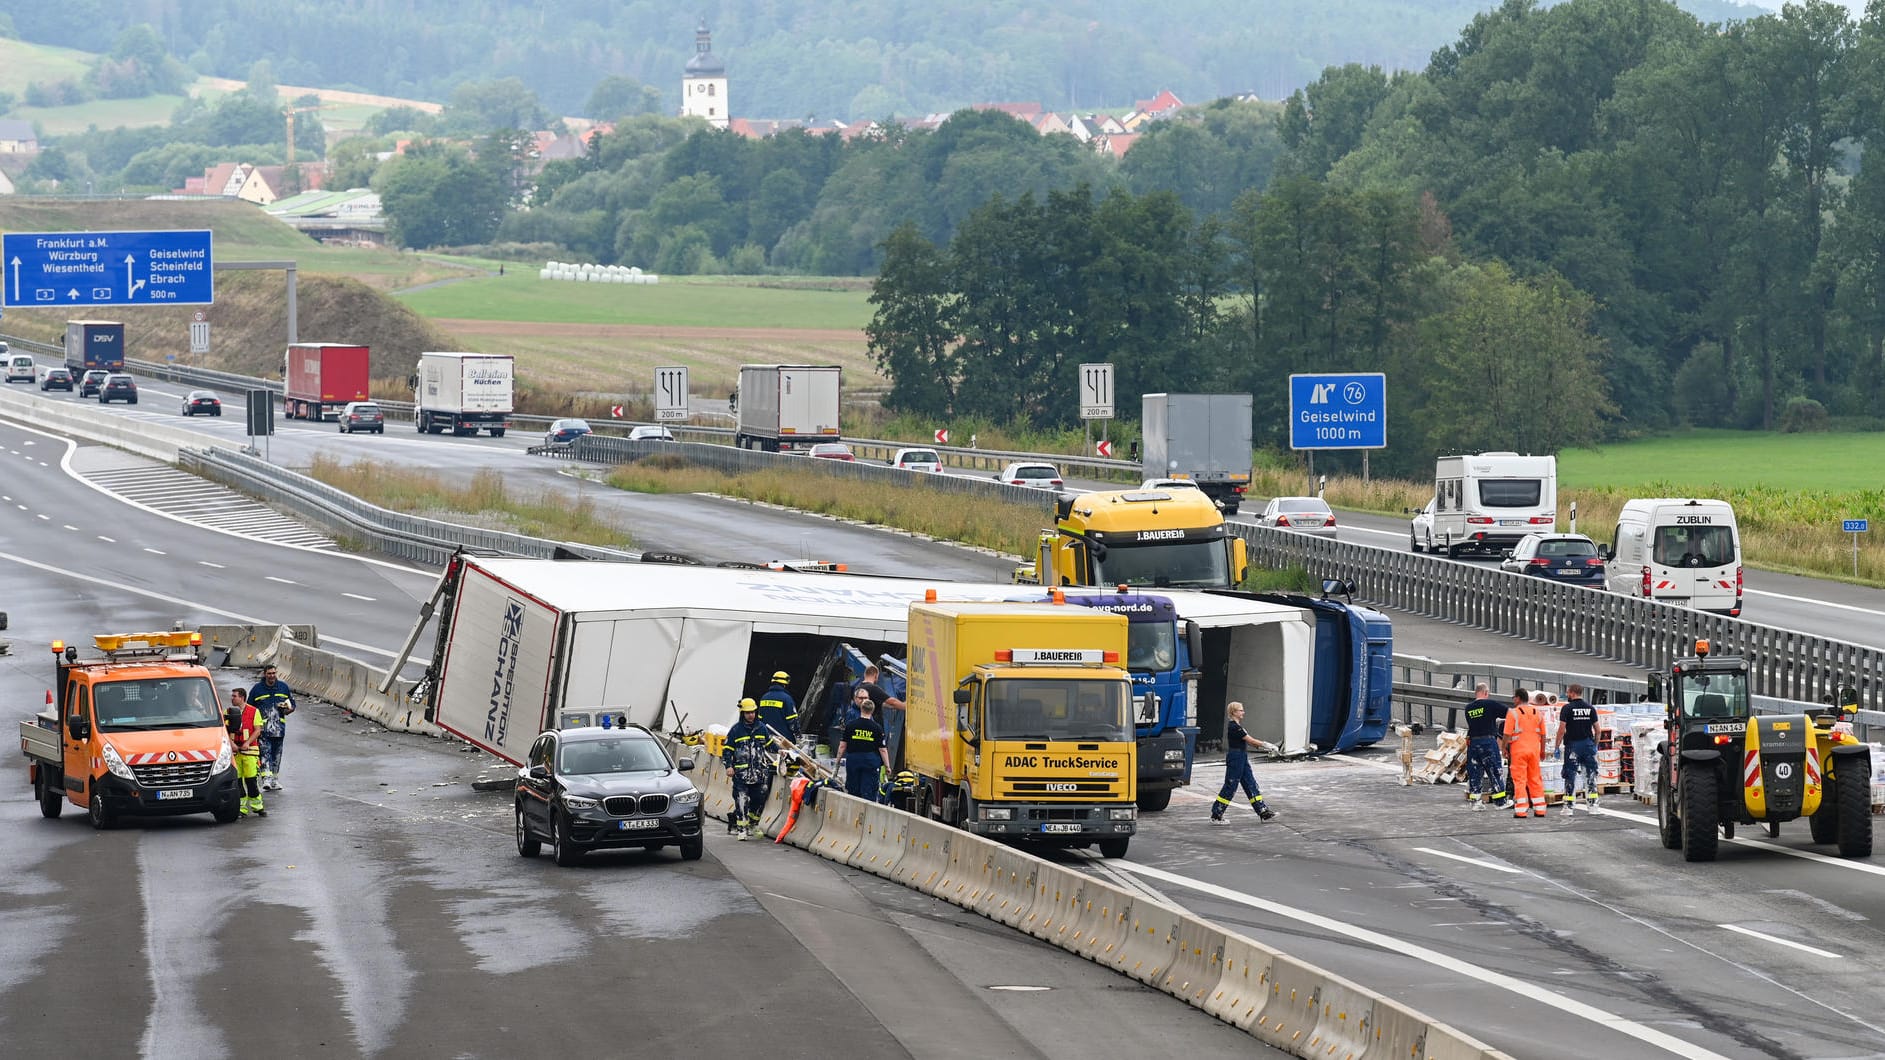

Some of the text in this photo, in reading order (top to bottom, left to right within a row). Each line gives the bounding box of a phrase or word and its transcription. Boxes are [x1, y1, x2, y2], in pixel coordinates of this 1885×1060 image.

[36, 238, 109, 248] Frankfurt a.M.
[48, 250, 98, 262] Würzburg
[149, 248, 205, 259] Geiselwind
[42, 262, 105, 273] Wiesentheid
[150, 261, 203, 271] Scheinfeld
[149, 274, 185, 284] Ebrach
[150, 290, 166, 299] 500
[93, 334, 114, 343] DSV
[1347, 386, 1362, 400] 76
[661, 410, 675, 418] 200
[1087, 408, 1100, 416] 200
[1300, 409, 1376, 423] Geiselwind
[1316, 427, 1361, 440] 1000 m
[484, 619, 512, 742] SCHANZ
[496, 641, 519, 747] SPEDITION
[1467, 707, 1484, 717] THW
[1572, 708, 1592, 716] THW
[855, 729, 873, 739] THW
[1004, 756, 1119, 769] ADAC TruckService
[1779, 765, 1789, 776] 40
[1046, 783, 1078, 792] IVECO
